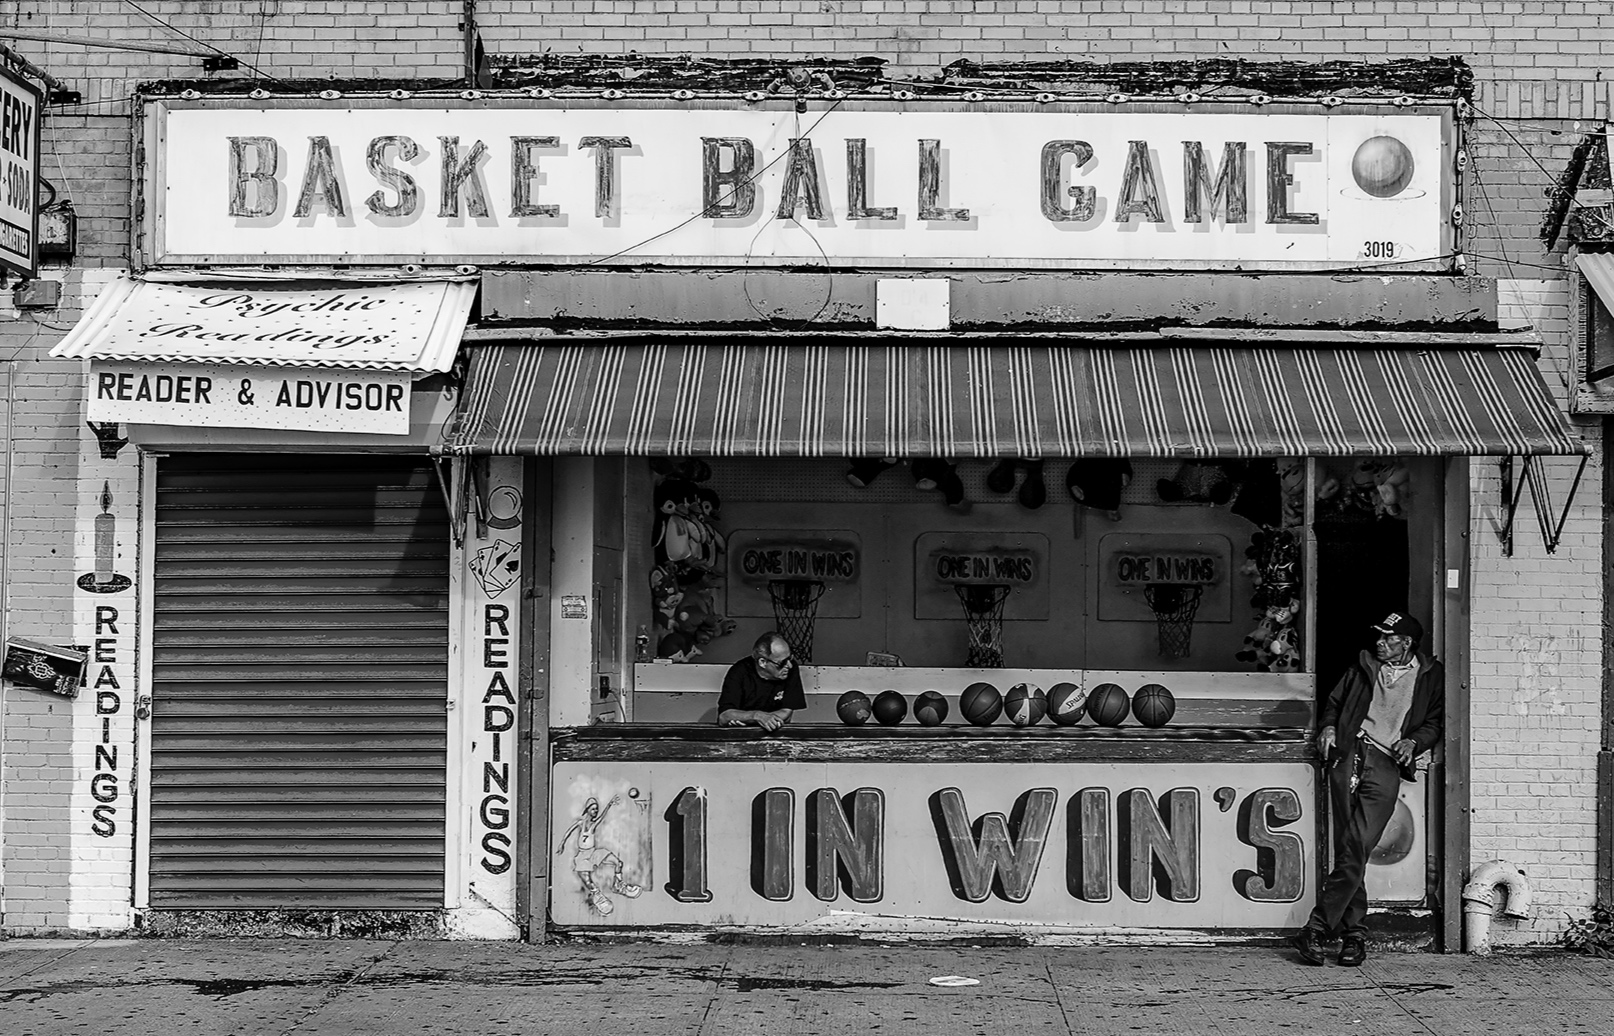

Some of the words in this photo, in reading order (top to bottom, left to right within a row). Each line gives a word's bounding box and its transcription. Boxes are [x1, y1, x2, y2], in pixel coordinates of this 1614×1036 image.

[0, 87, 32, 161] ERY
[7, 160, 30, 215] SODA
[226, 136, 643, 228] BASKET
[701, 138, 977, 228] BALL
[1039, 140, 1327, 233] GAME
[1363, 241, 1394, 258] 3019
[188, 294, 386, 318] Psychic
[139, 323, 390, 350] Readings
[96, 372, 212, 405] READER
[237, 378, 255, 406] &
[276, 380, 404, 412] ADVISOR
[743, 550, 783, 575] ONE
[787, 550, 807, 575] IN
[811, 552, 854, 577] WINS
[937, 555, 970, 579] ONE
[973, 557, 990, 578] IN
[993, 557, 1032, 581] WINS
[1118, 557, 1151, 581] ONE
[1174, 558, 1214, 581] WINS
[91, 606, 120, 838] READINGS
[480, 604, 516, 875] READINGS
[582, 835, 589, 843] 7
[663, 787, 713, 903] 1
[751, 787, 884, 903] IN
[927, 787, 1304, 903] WIN'S
